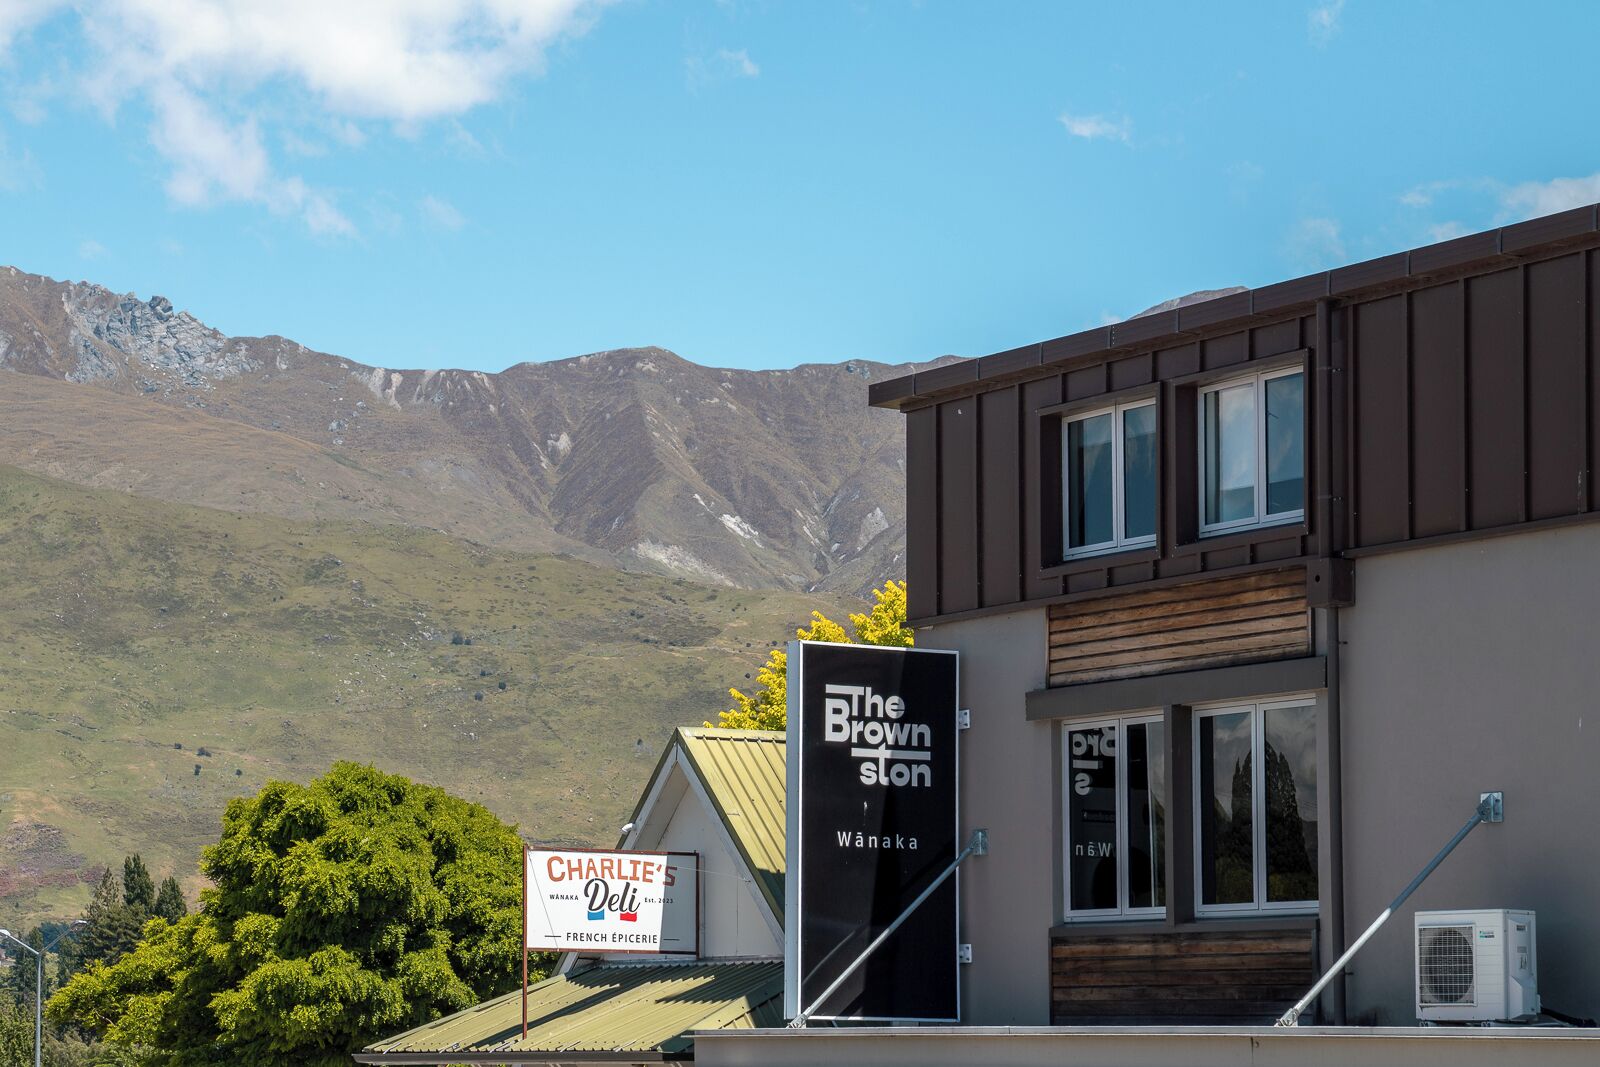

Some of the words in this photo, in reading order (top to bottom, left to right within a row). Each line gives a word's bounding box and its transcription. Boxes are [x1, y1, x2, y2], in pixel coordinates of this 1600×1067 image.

[825, 683, 905, 719] The
[825, 697, 931, 747] Brown
[851, 742, 931, 787] ston
[837, 830, 918, 850] Wānaka
[583, 877, 641, 913] Deli
[566, 932, 607, 943] FRENCH
[611, 931, 658, 944] ÉPICERIE
